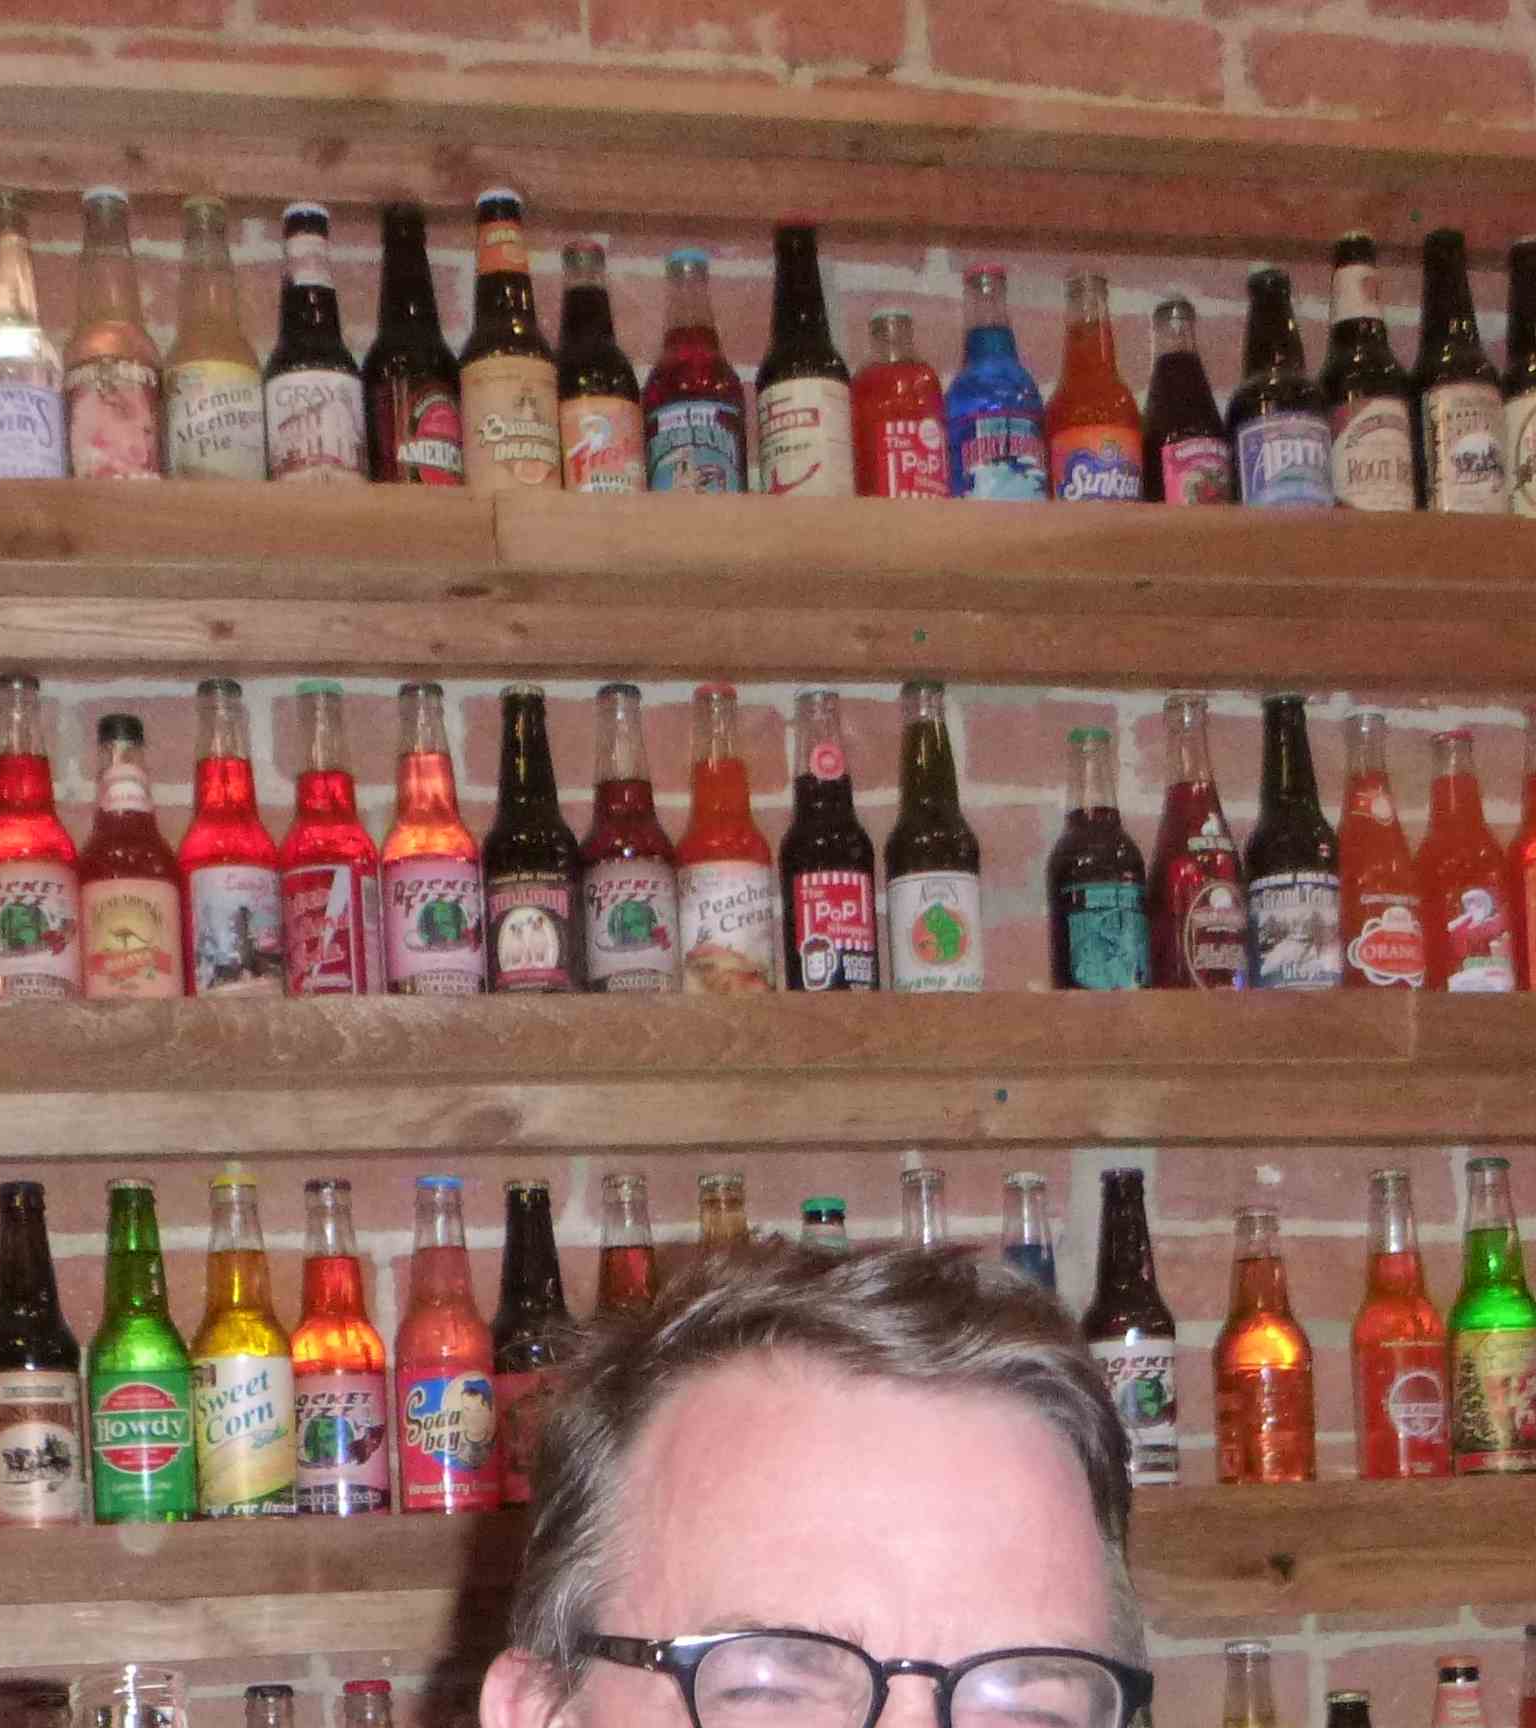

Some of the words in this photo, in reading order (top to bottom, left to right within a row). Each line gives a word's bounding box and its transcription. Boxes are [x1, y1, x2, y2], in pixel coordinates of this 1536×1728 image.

[198, 433, 232, 460] Pie
[95, 1415, 186, 1444] Howdy
[205, 1398, 276, 1447] Corn
